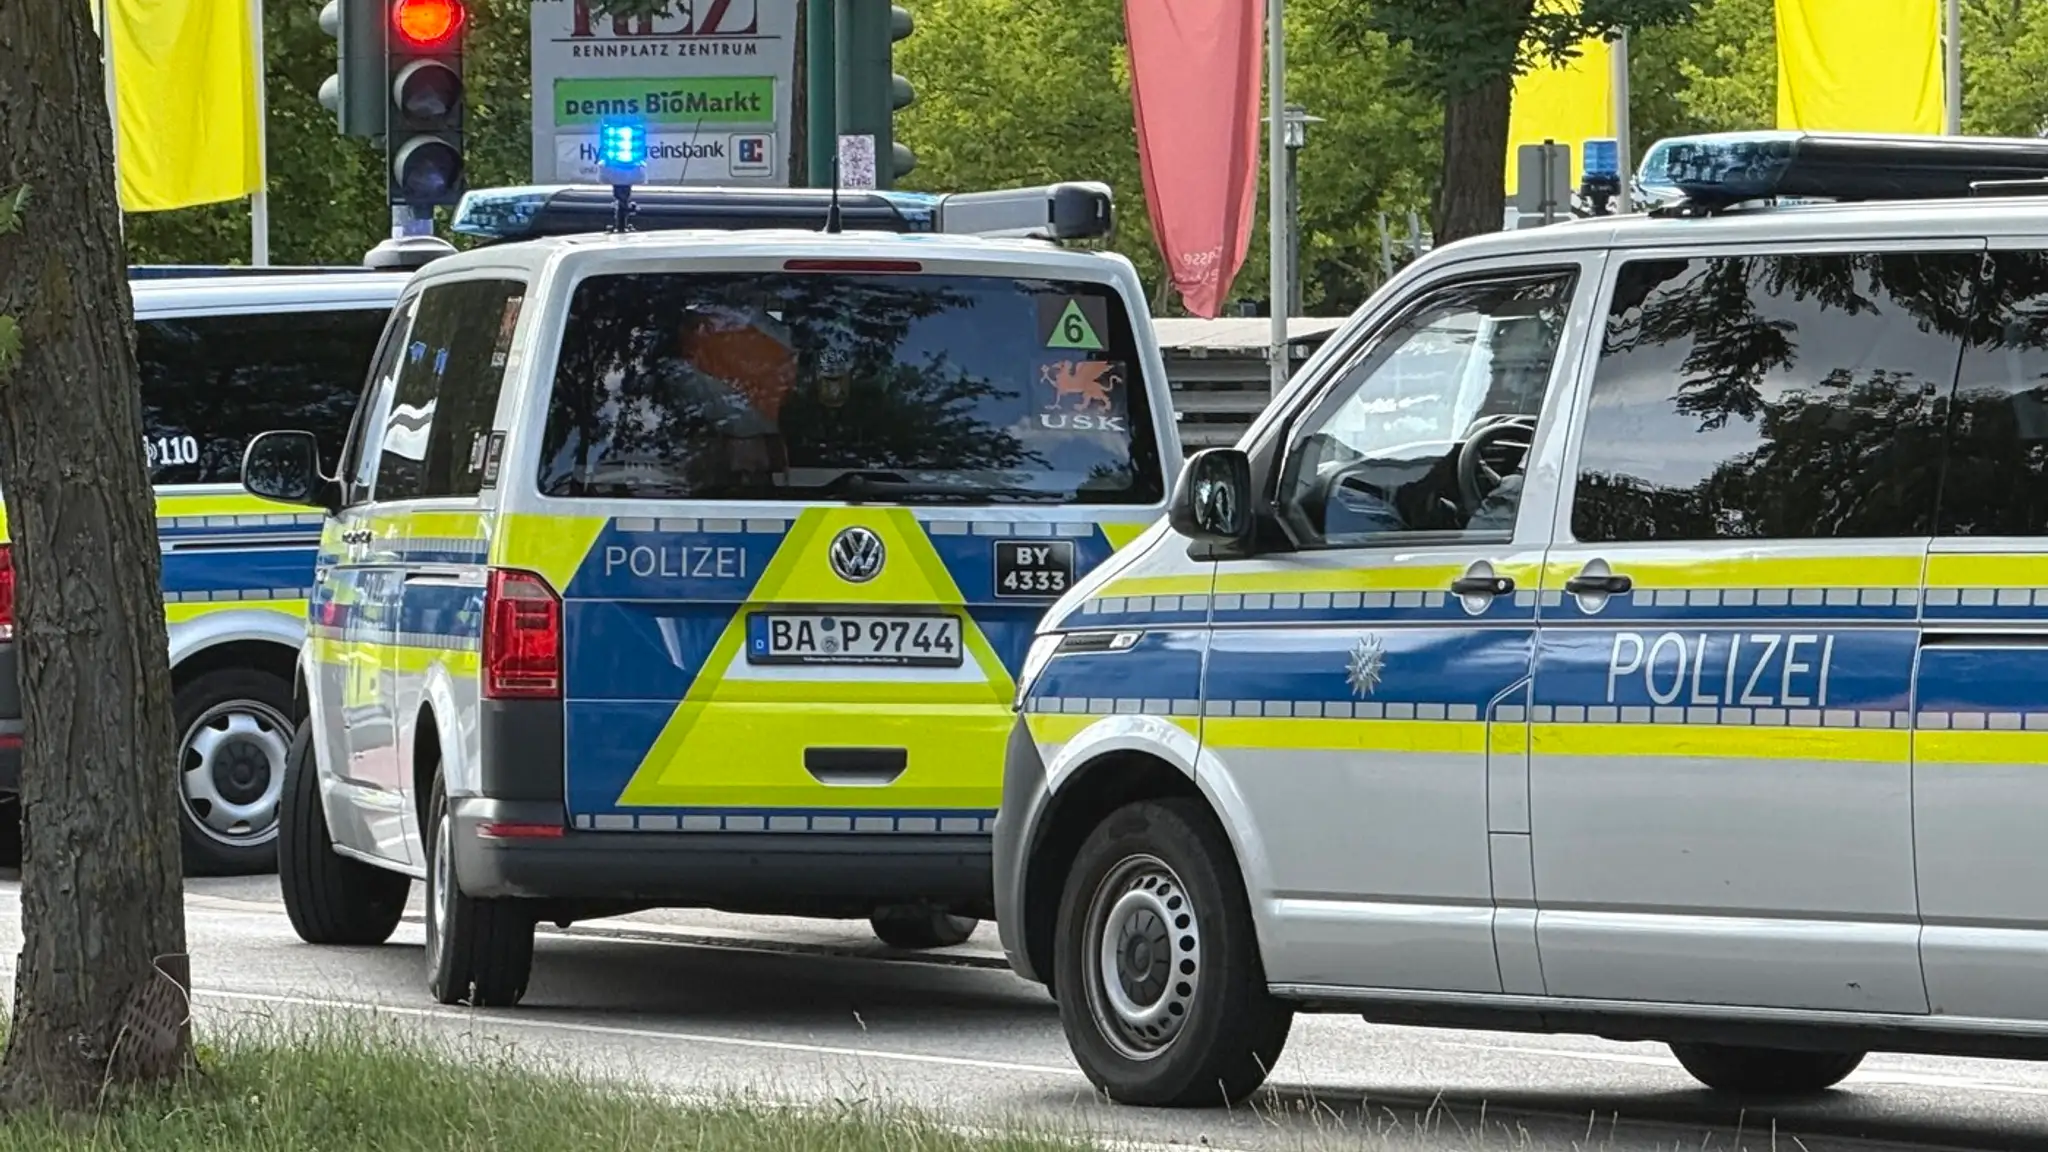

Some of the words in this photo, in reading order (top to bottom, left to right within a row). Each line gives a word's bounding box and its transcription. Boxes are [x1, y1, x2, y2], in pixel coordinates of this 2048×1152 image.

[573, 44, 669, 57] RENNPLATZ
[678, 43, 758, 56] ZENTRUM
[645, 90, 761, 114] BioMarkt
[579, 141, 725, 165] Hyreinsbank
[1064, 313, 1084, 343] 6
[1040, 413, 1125, 432] USK
[158, 436, 199, 465] 110
[605, 545, 746, 578] POLIZEI
[1016, 547, 1050, 565] BY
[1003, 571, 1065, 590] 4333
[771, 620, 817, 651] BA
[840, 620, 861, 652] P
[869, 621, 954, 653] 9744
[1607, 631, 1834, 706] POLIZEI
